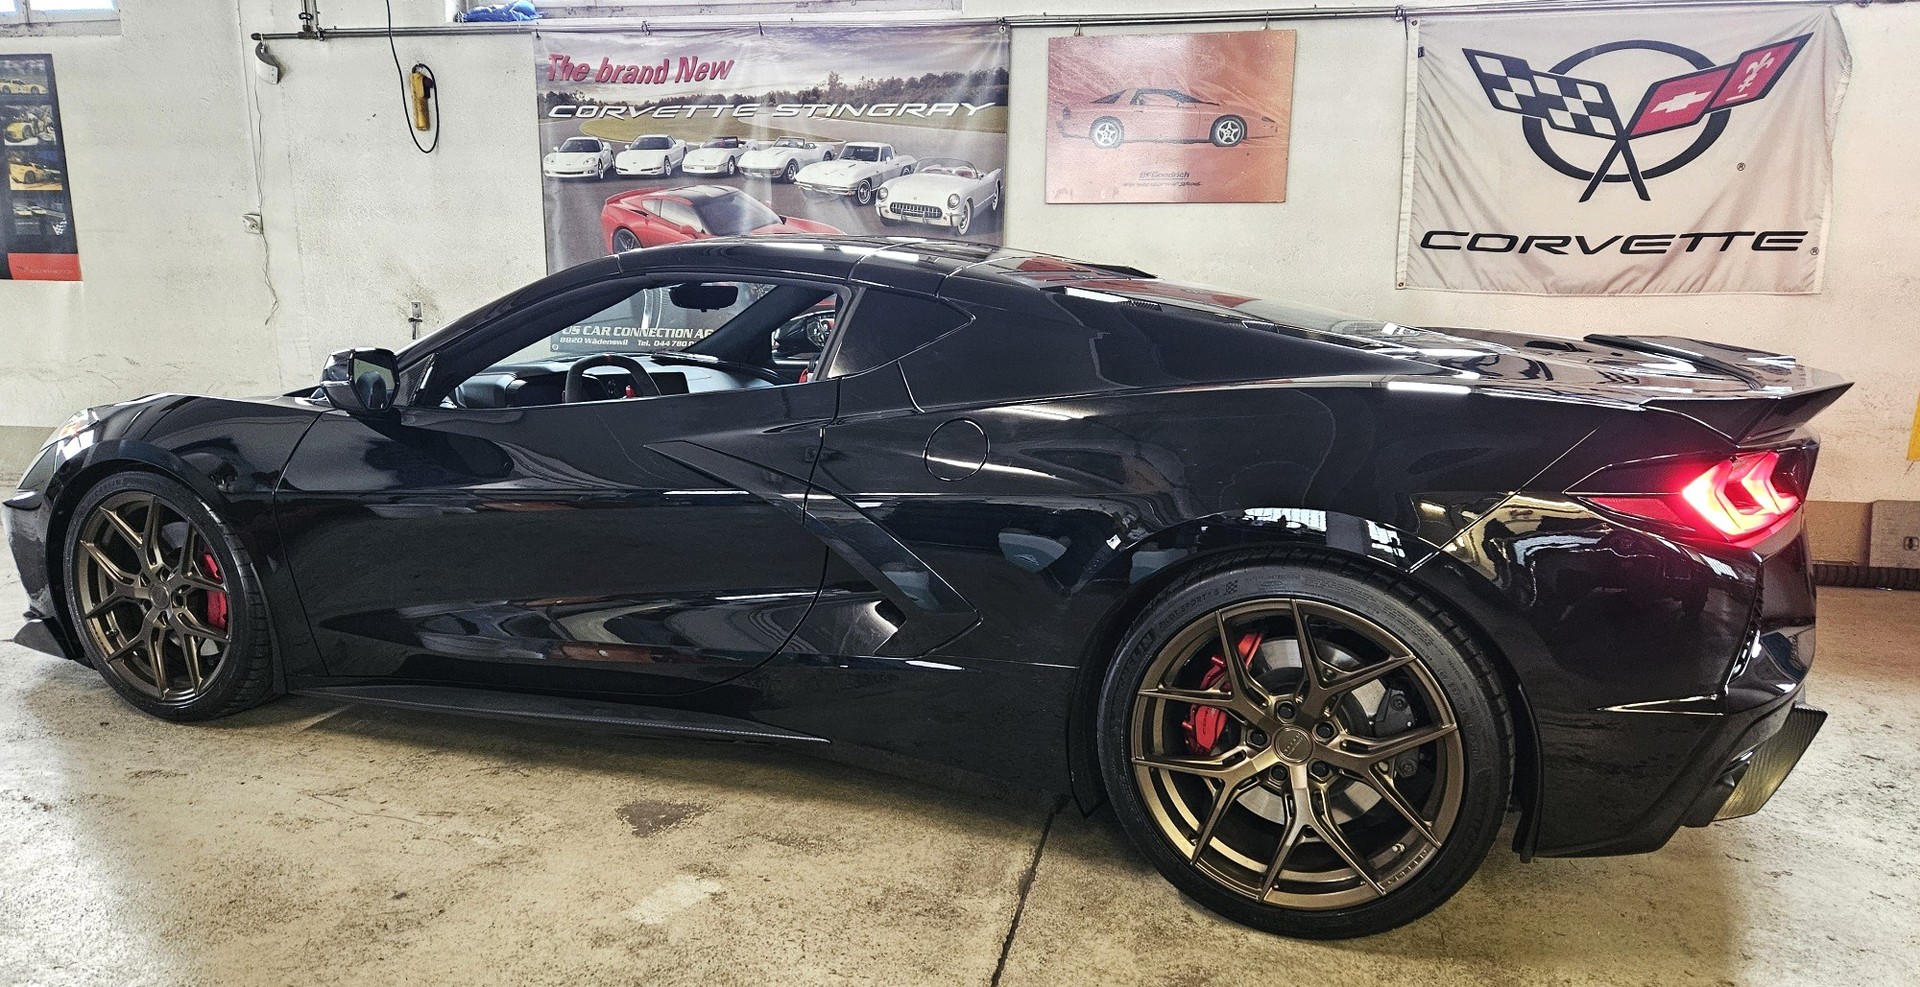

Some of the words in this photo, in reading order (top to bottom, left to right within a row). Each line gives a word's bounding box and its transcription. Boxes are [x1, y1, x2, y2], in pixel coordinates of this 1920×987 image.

[548, 53, 591, 82] The
[594, 56, 670, 85] brand
[674, 55, 735, 84] New
[548, 104, 760, 120] CORVETTE
[772, 102, 996, 119] STINGRAY
[1420, 230, 1809, 256] CORVETTE
[561, 325, 581, 335] US
[582, 325, 612, 336] CAR
[613, 327, 694, 339] CONNECTION
[637, 339, 651, 347] Tel.
